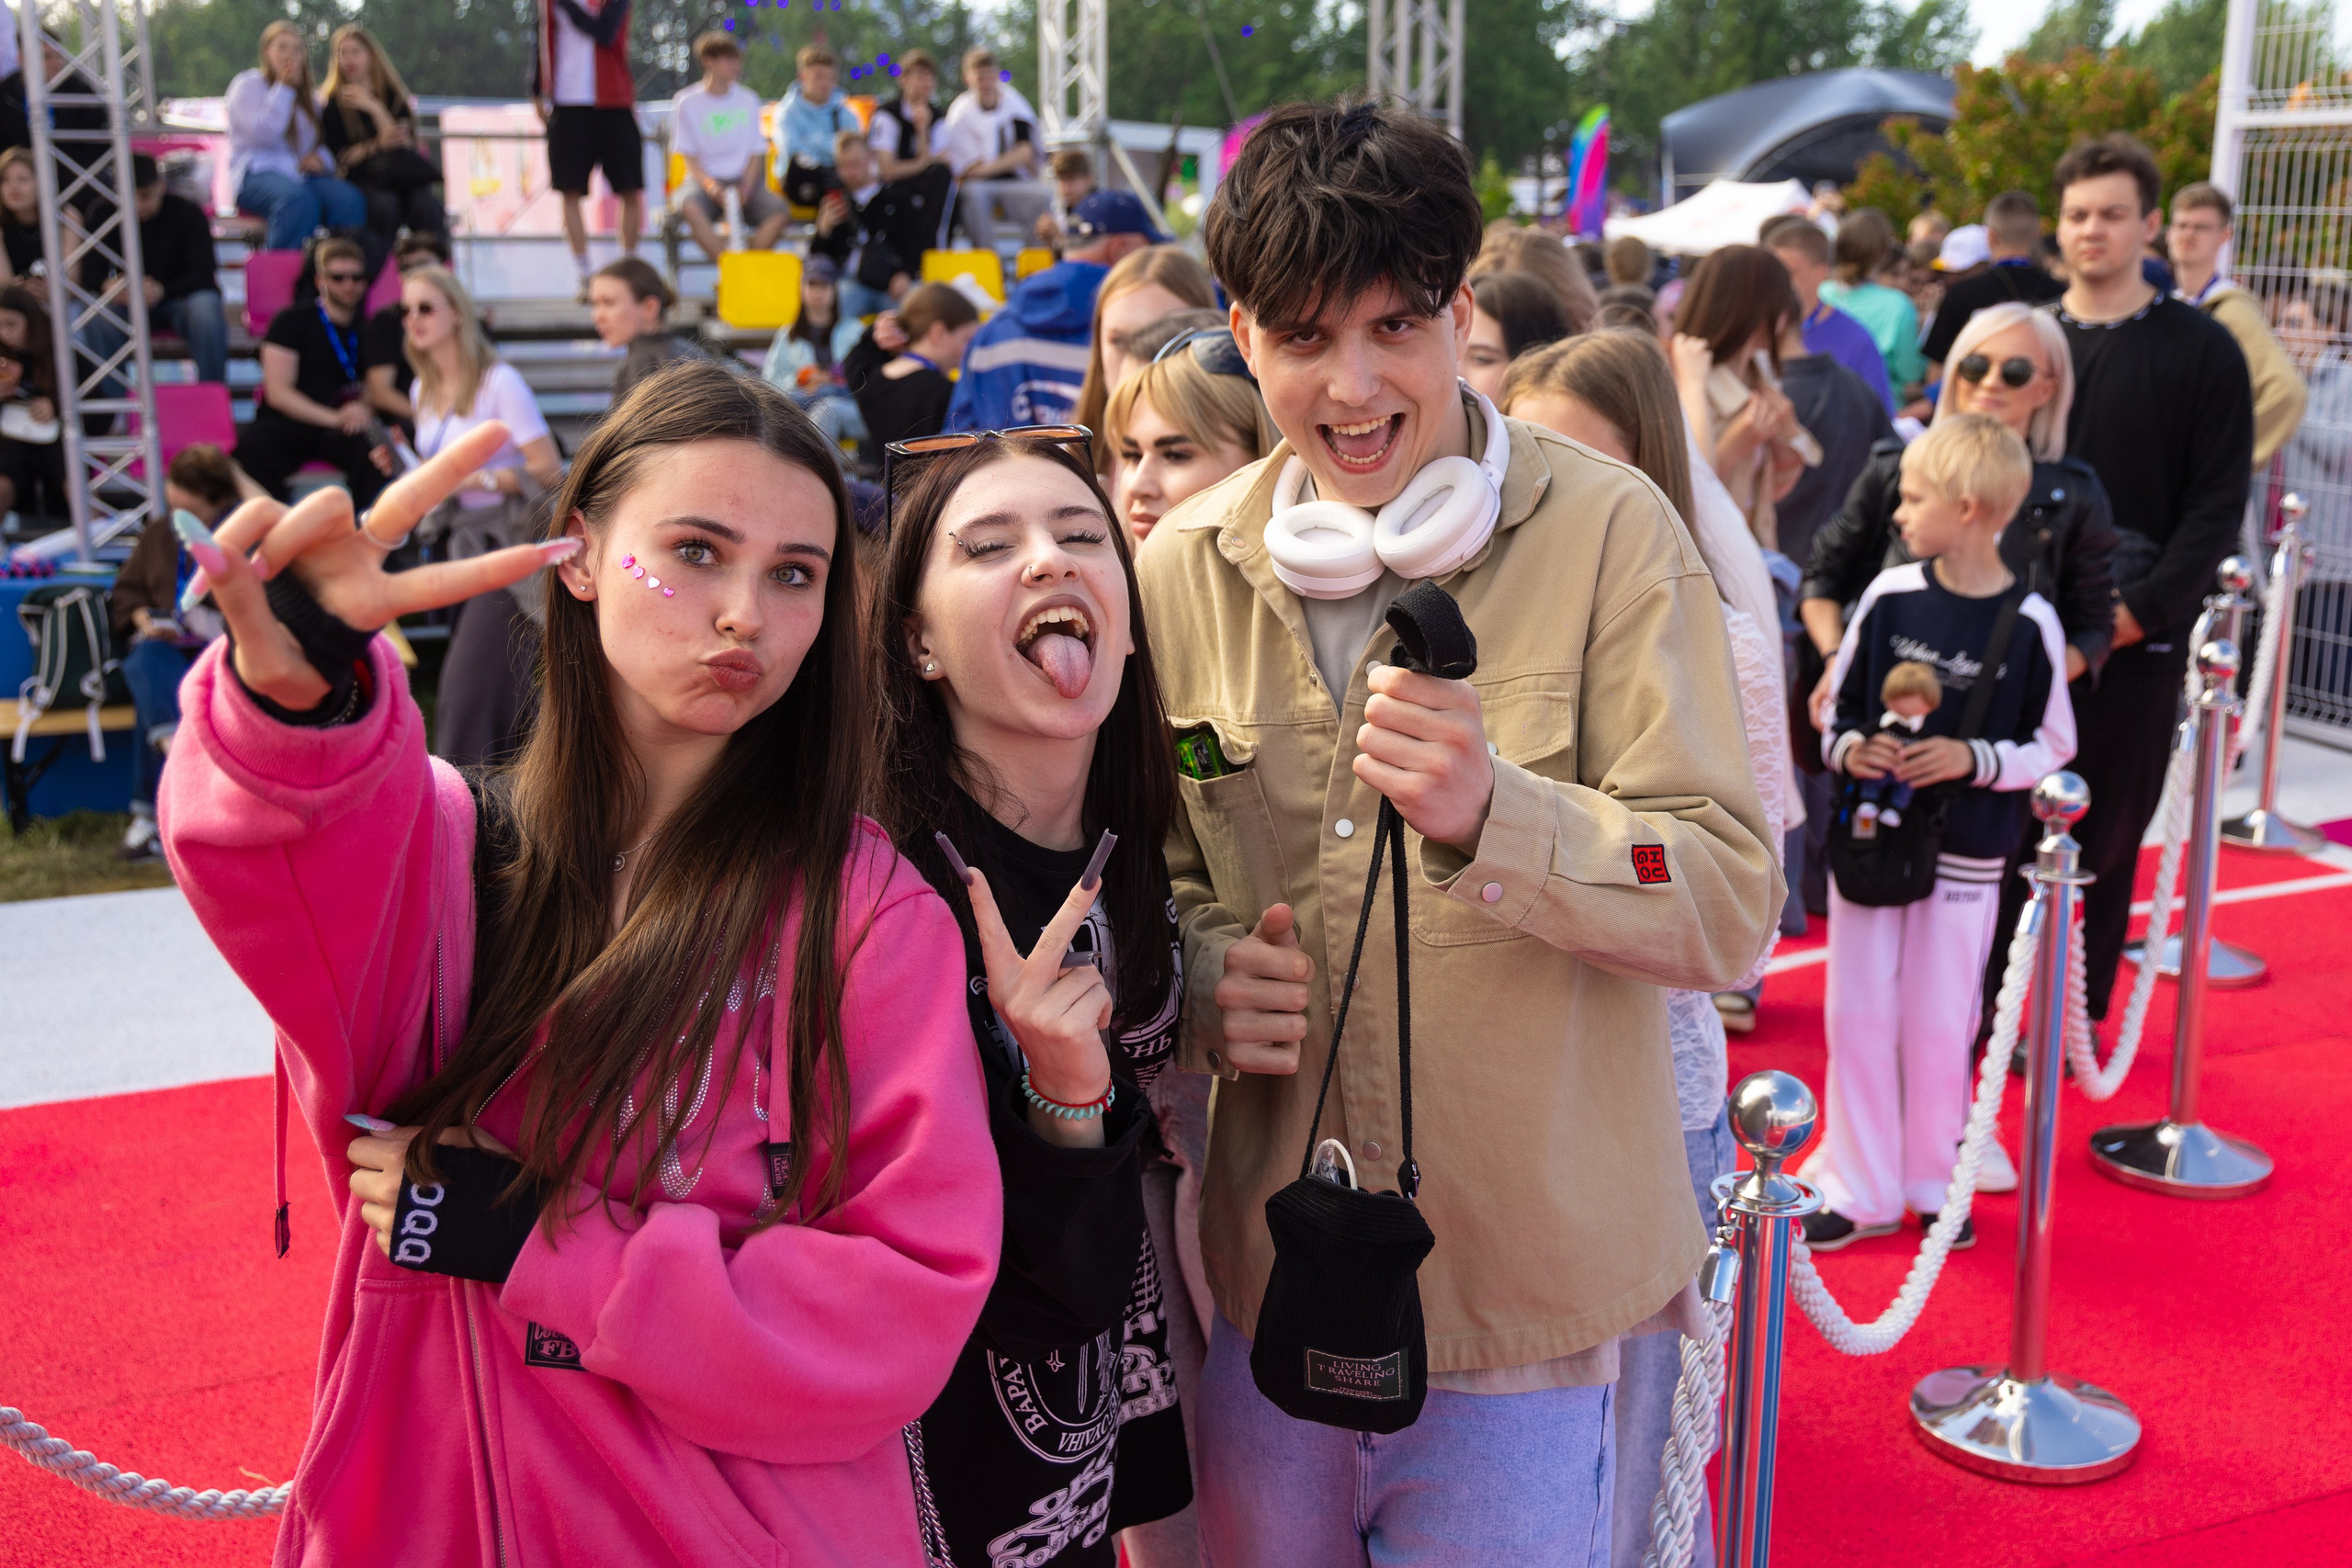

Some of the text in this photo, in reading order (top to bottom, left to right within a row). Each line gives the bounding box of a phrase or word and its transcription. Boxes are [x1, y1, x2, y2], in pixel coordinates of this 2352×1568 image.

[540, 1341, 578, 1358] FB
[1333, 1360, 1381, 1371] LIVING
[1335, 1375, 1381, 1386] SHARE
